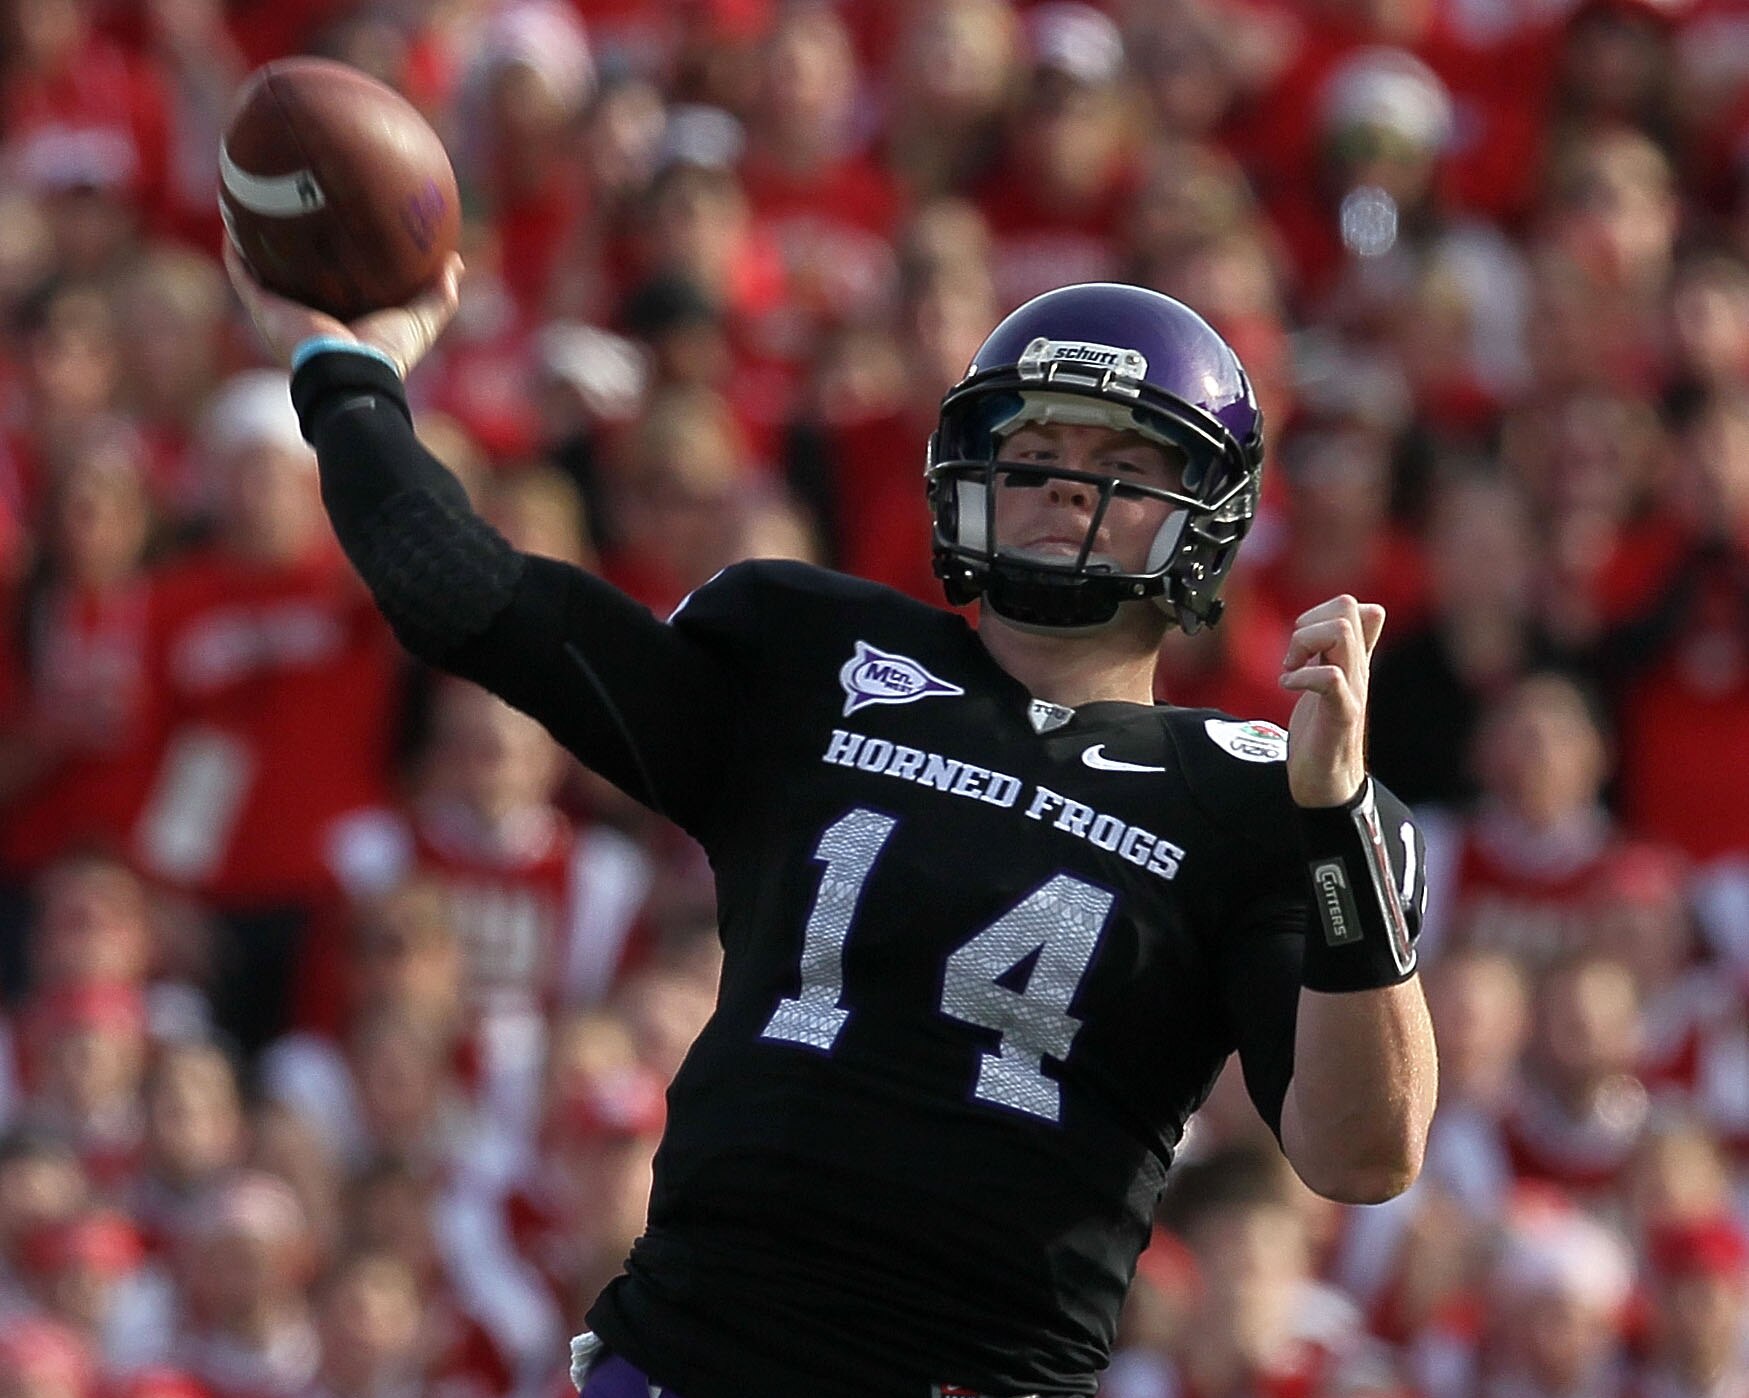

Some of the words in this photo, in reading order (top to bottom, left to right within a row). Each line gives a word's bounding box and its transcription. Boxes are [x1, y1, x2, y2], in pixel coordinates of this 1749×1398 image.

[1054, 347, 1118, 365] schutt
[822, 729, 1023, 808] HORNED
[1025, 786, 1186, 880] FROGS
